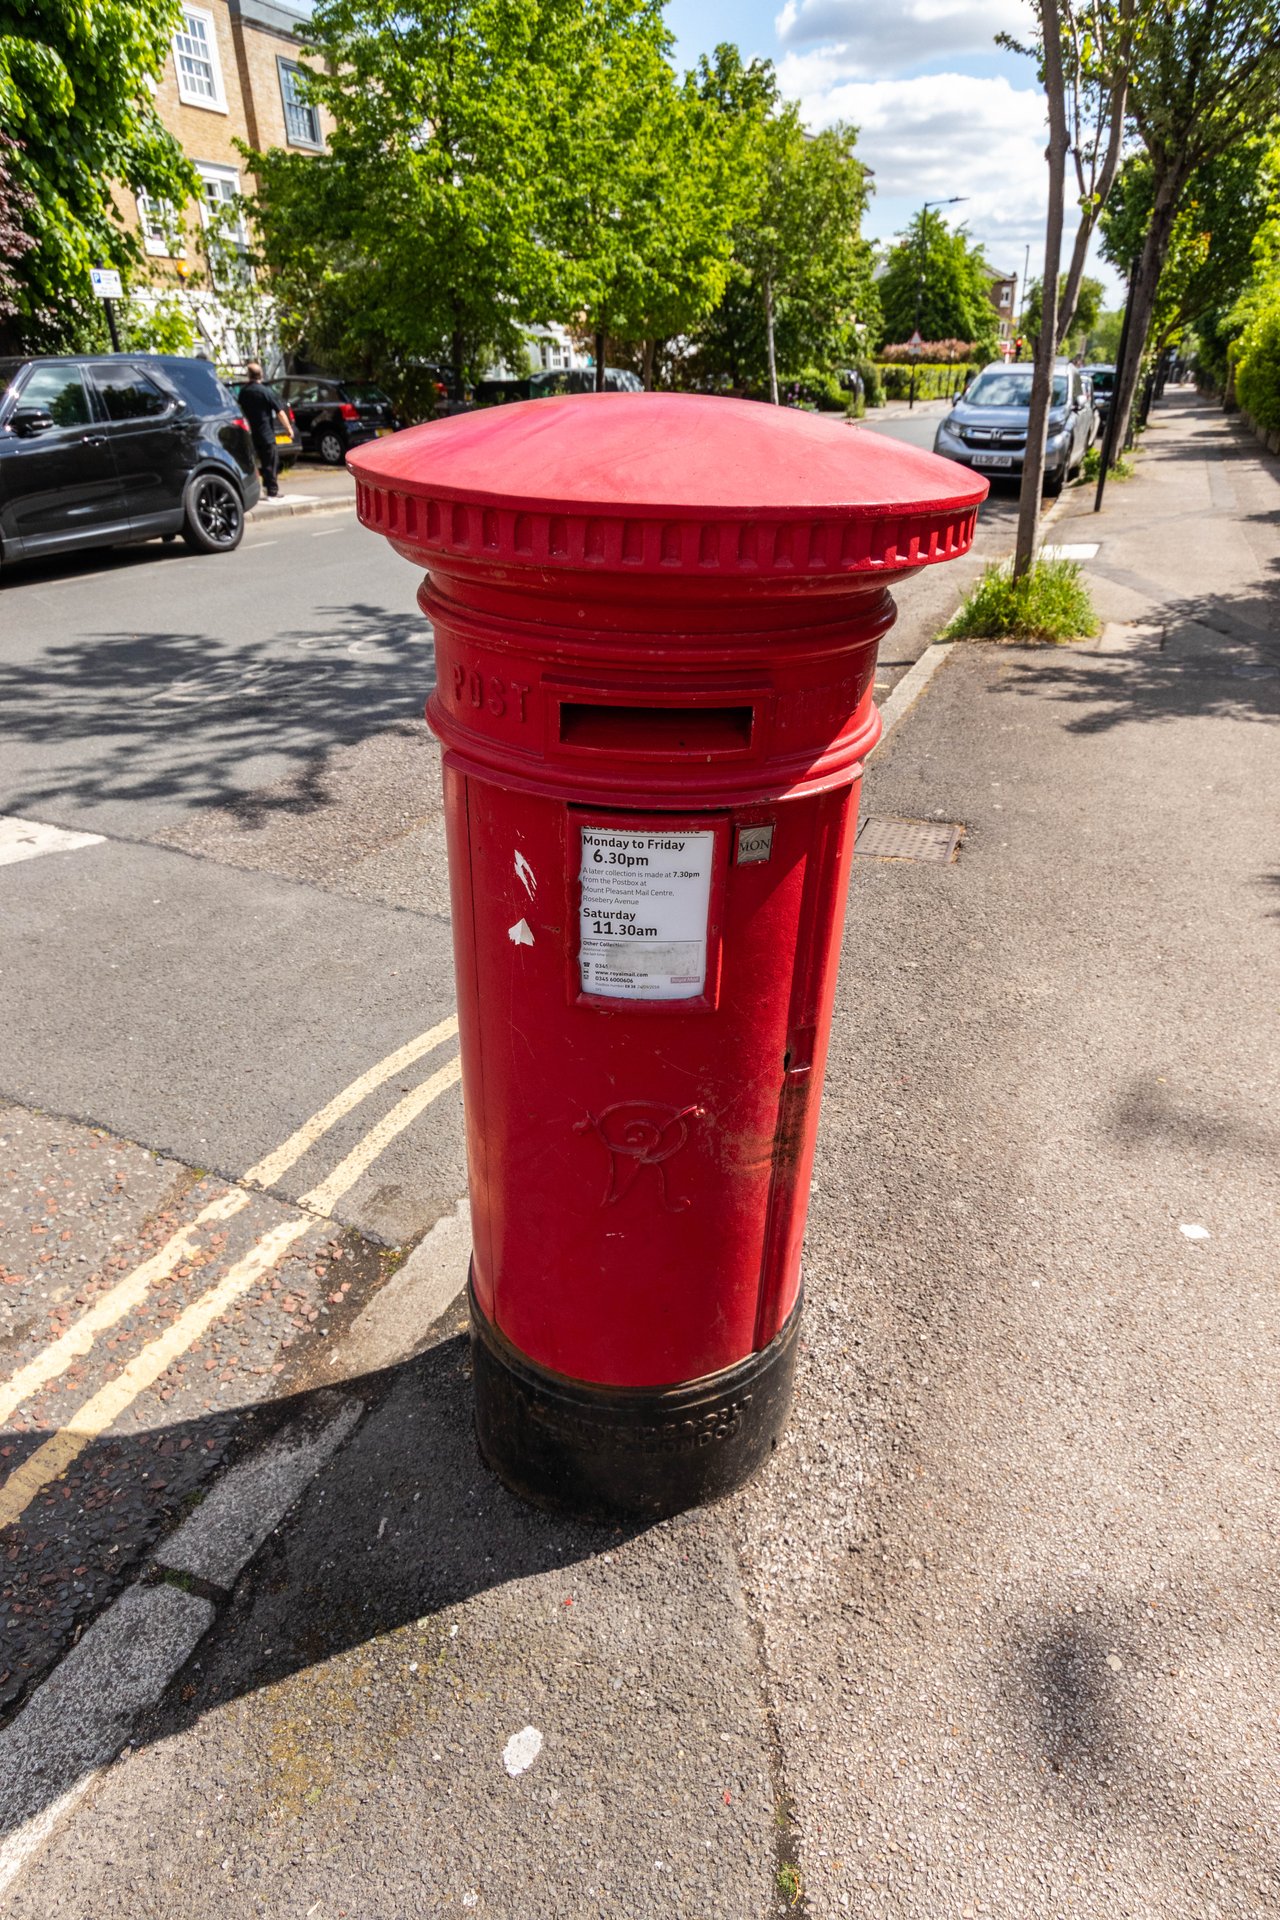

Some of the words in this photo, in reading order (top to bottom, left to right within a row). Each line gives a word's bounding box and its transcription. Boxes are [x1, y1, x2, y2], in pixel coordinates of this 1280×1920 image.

[452, 662, 530, 723] POST
[583, 835, 629, 850] Monday
[632, 840, 644, 849] to
[647, 839, 685, 852] Friday
[740, 839, 770, 852] MON
[593, 849, 649, 868] 6.30pm
[589, 868, 604, 876] later
[605, 869, 636, 878] collection
[644, 871, 664, 879] made
[672, 871, 700, 880] 7.30pm
[583, 876, 599, 884] from
[600, 877, 611, 885] the
[612, 878, 639, 886] Postbox
[583, 886, 604, 894] Mount
[605, 887, 634, 896] Pleasant
[583, 895, 614, 905] Rosebery
[614, 897, 640, 906] Avenue
[583, 907, 636, 922] Saturday
[592, 920, 658, 937] 11.30am
[595, 970, 649, 978] www.royalmail.com
